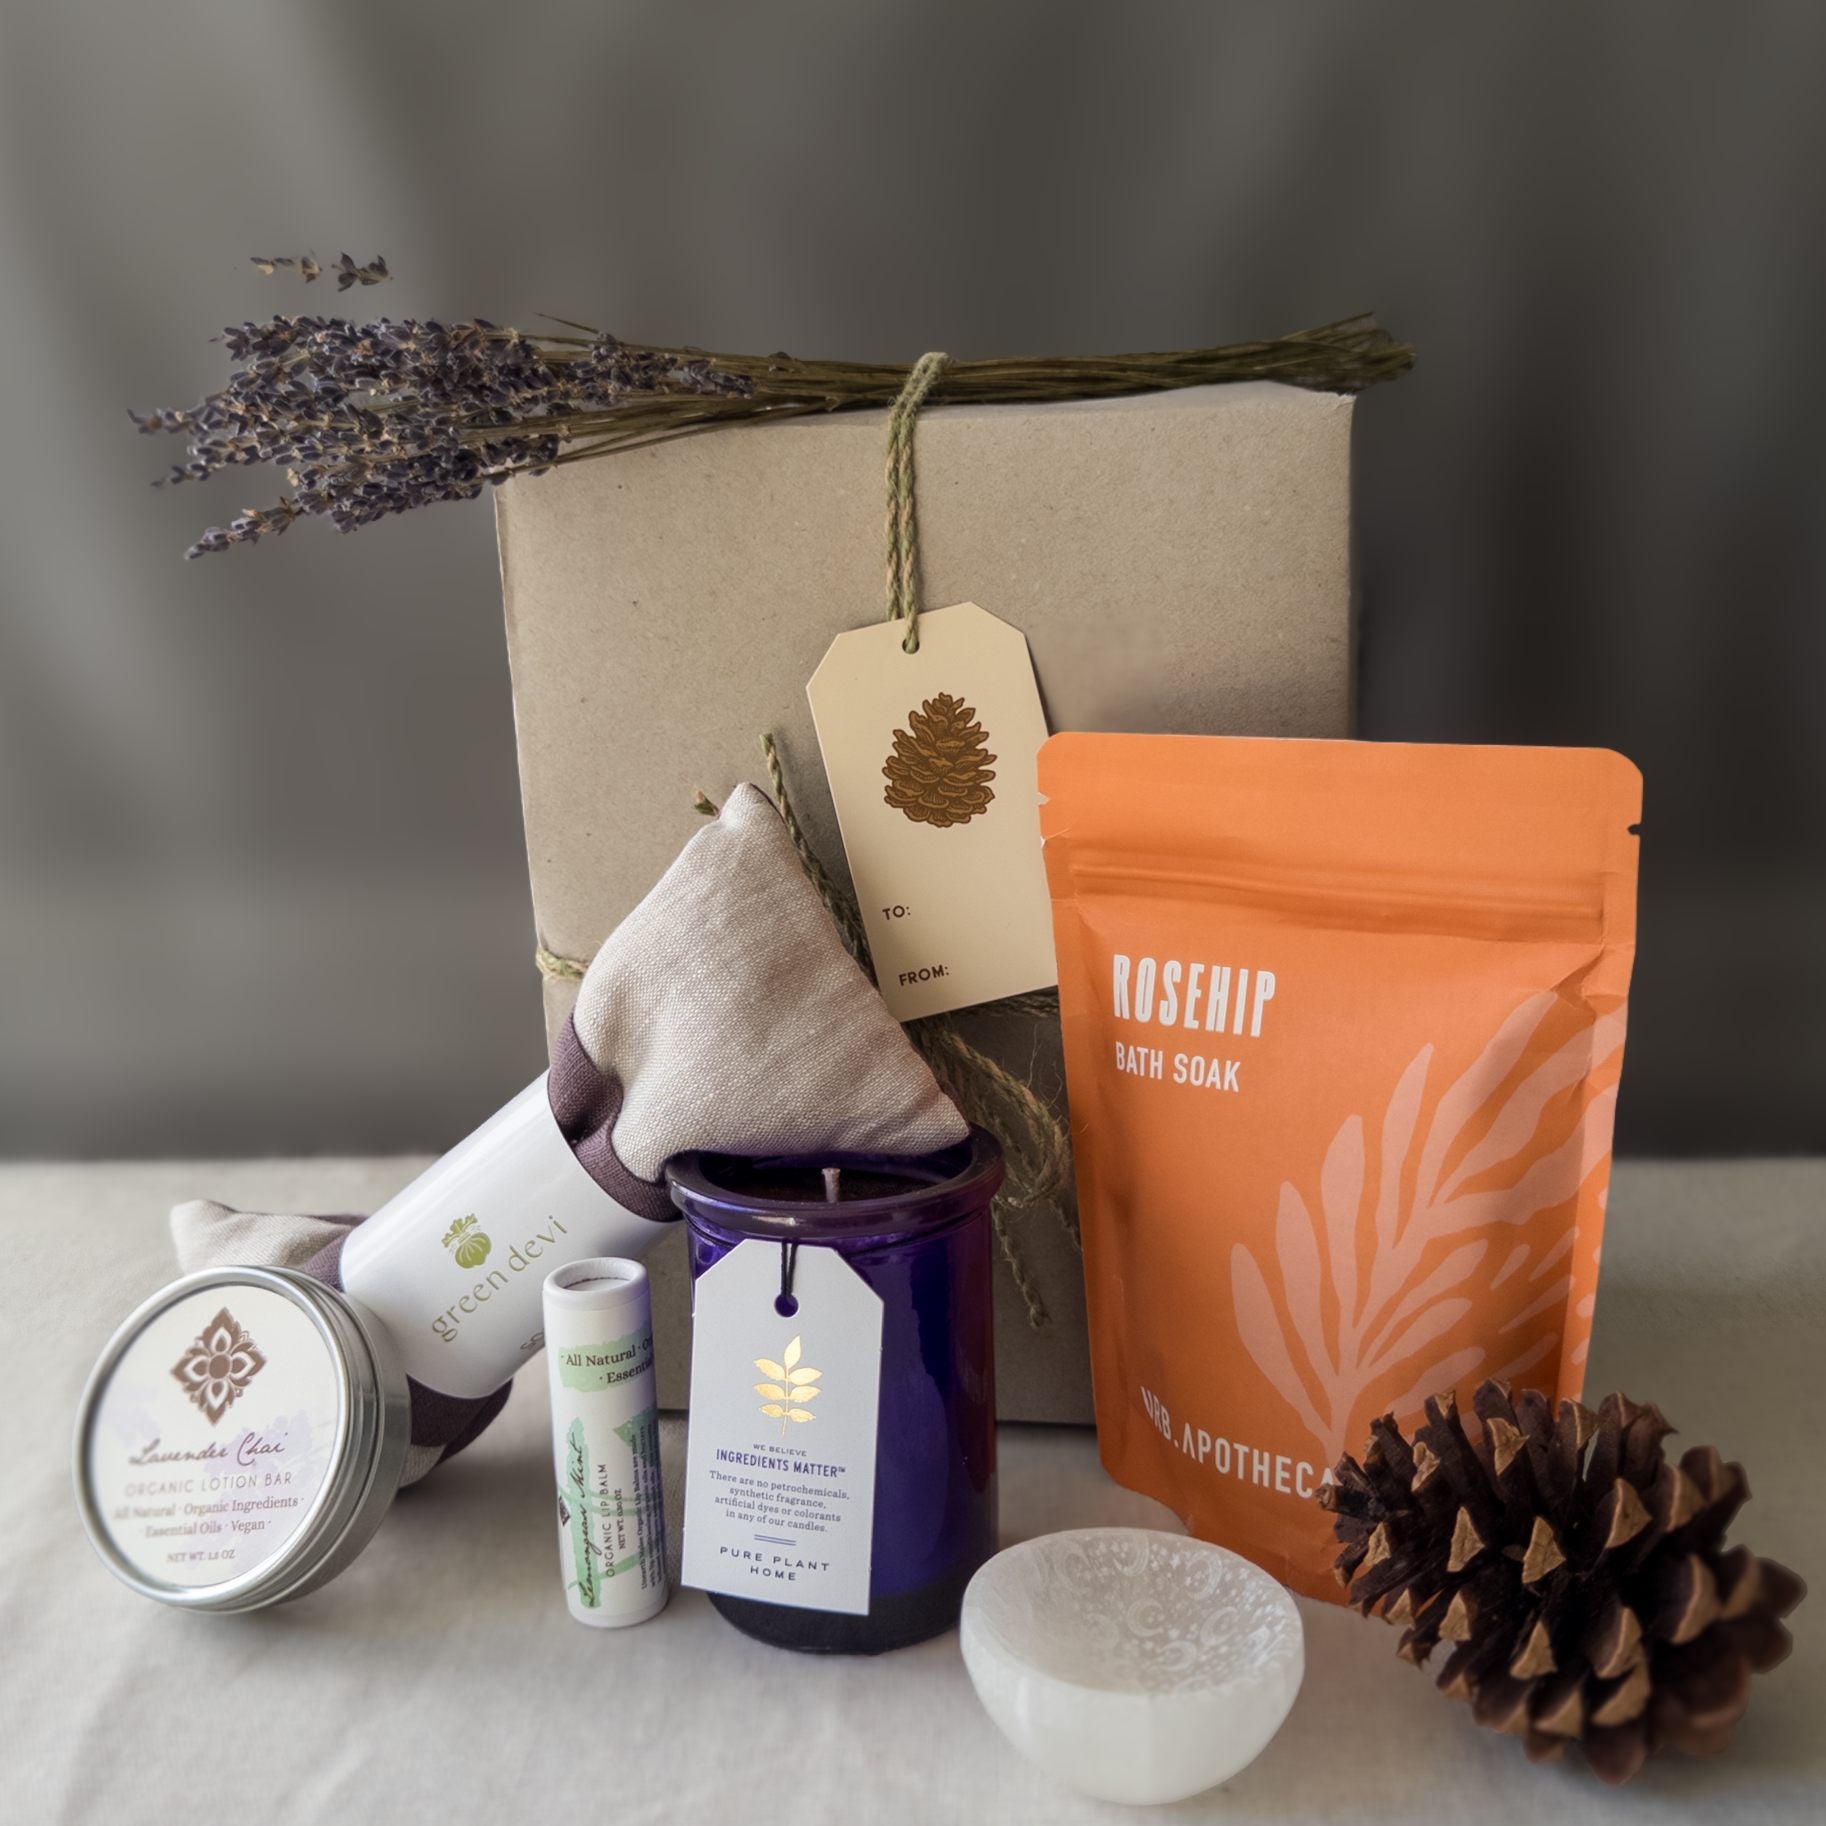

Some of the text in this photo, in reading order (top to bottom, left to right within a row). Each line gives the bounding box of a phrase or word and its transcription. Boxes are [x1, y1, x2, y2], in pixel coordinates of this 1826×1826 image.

[882, 905, 911, 920] TO:
[898, 964, 949, 986] FROM:
[1113, 953, 1276, 1038] ROSEHIP
[1115, 1041, 1241, 1092] BATH SOAK
[566, 1344, 636, 1367] All Natural
[128, 1431, 288, 1467] Lavender Chai
[716, 1448, 789, 1472] INGREDIENTS
[753, 1443, 807, 1457] WE BELIEVE
[125, 1472, 292, 1498] ORGANIC LOTION BAR
[709, 1470, 850, 1500] There are no petrochemicals,
[183, 1500, 229, 1517] Organic
[232, 1496, 299, 1514] Ingredients
[714, 1495, 841, 1523] artificial dyes or colorants
[729, 1487, 827, 1510] synthetic fragrance,
[199, 1520, 223, 1536] Oils
[231, 1519, 266, 1534] Vegan
[597, 1464, 616, 1578] ORGANIC LIP BALM
[726, 1509, 828, 1533] in any of our candles.
[617, 1533, 626, 1550] NET
[720, 1546, 831, 1571] PURE PLANT
[750, 1565, 797, 1581] HOME
